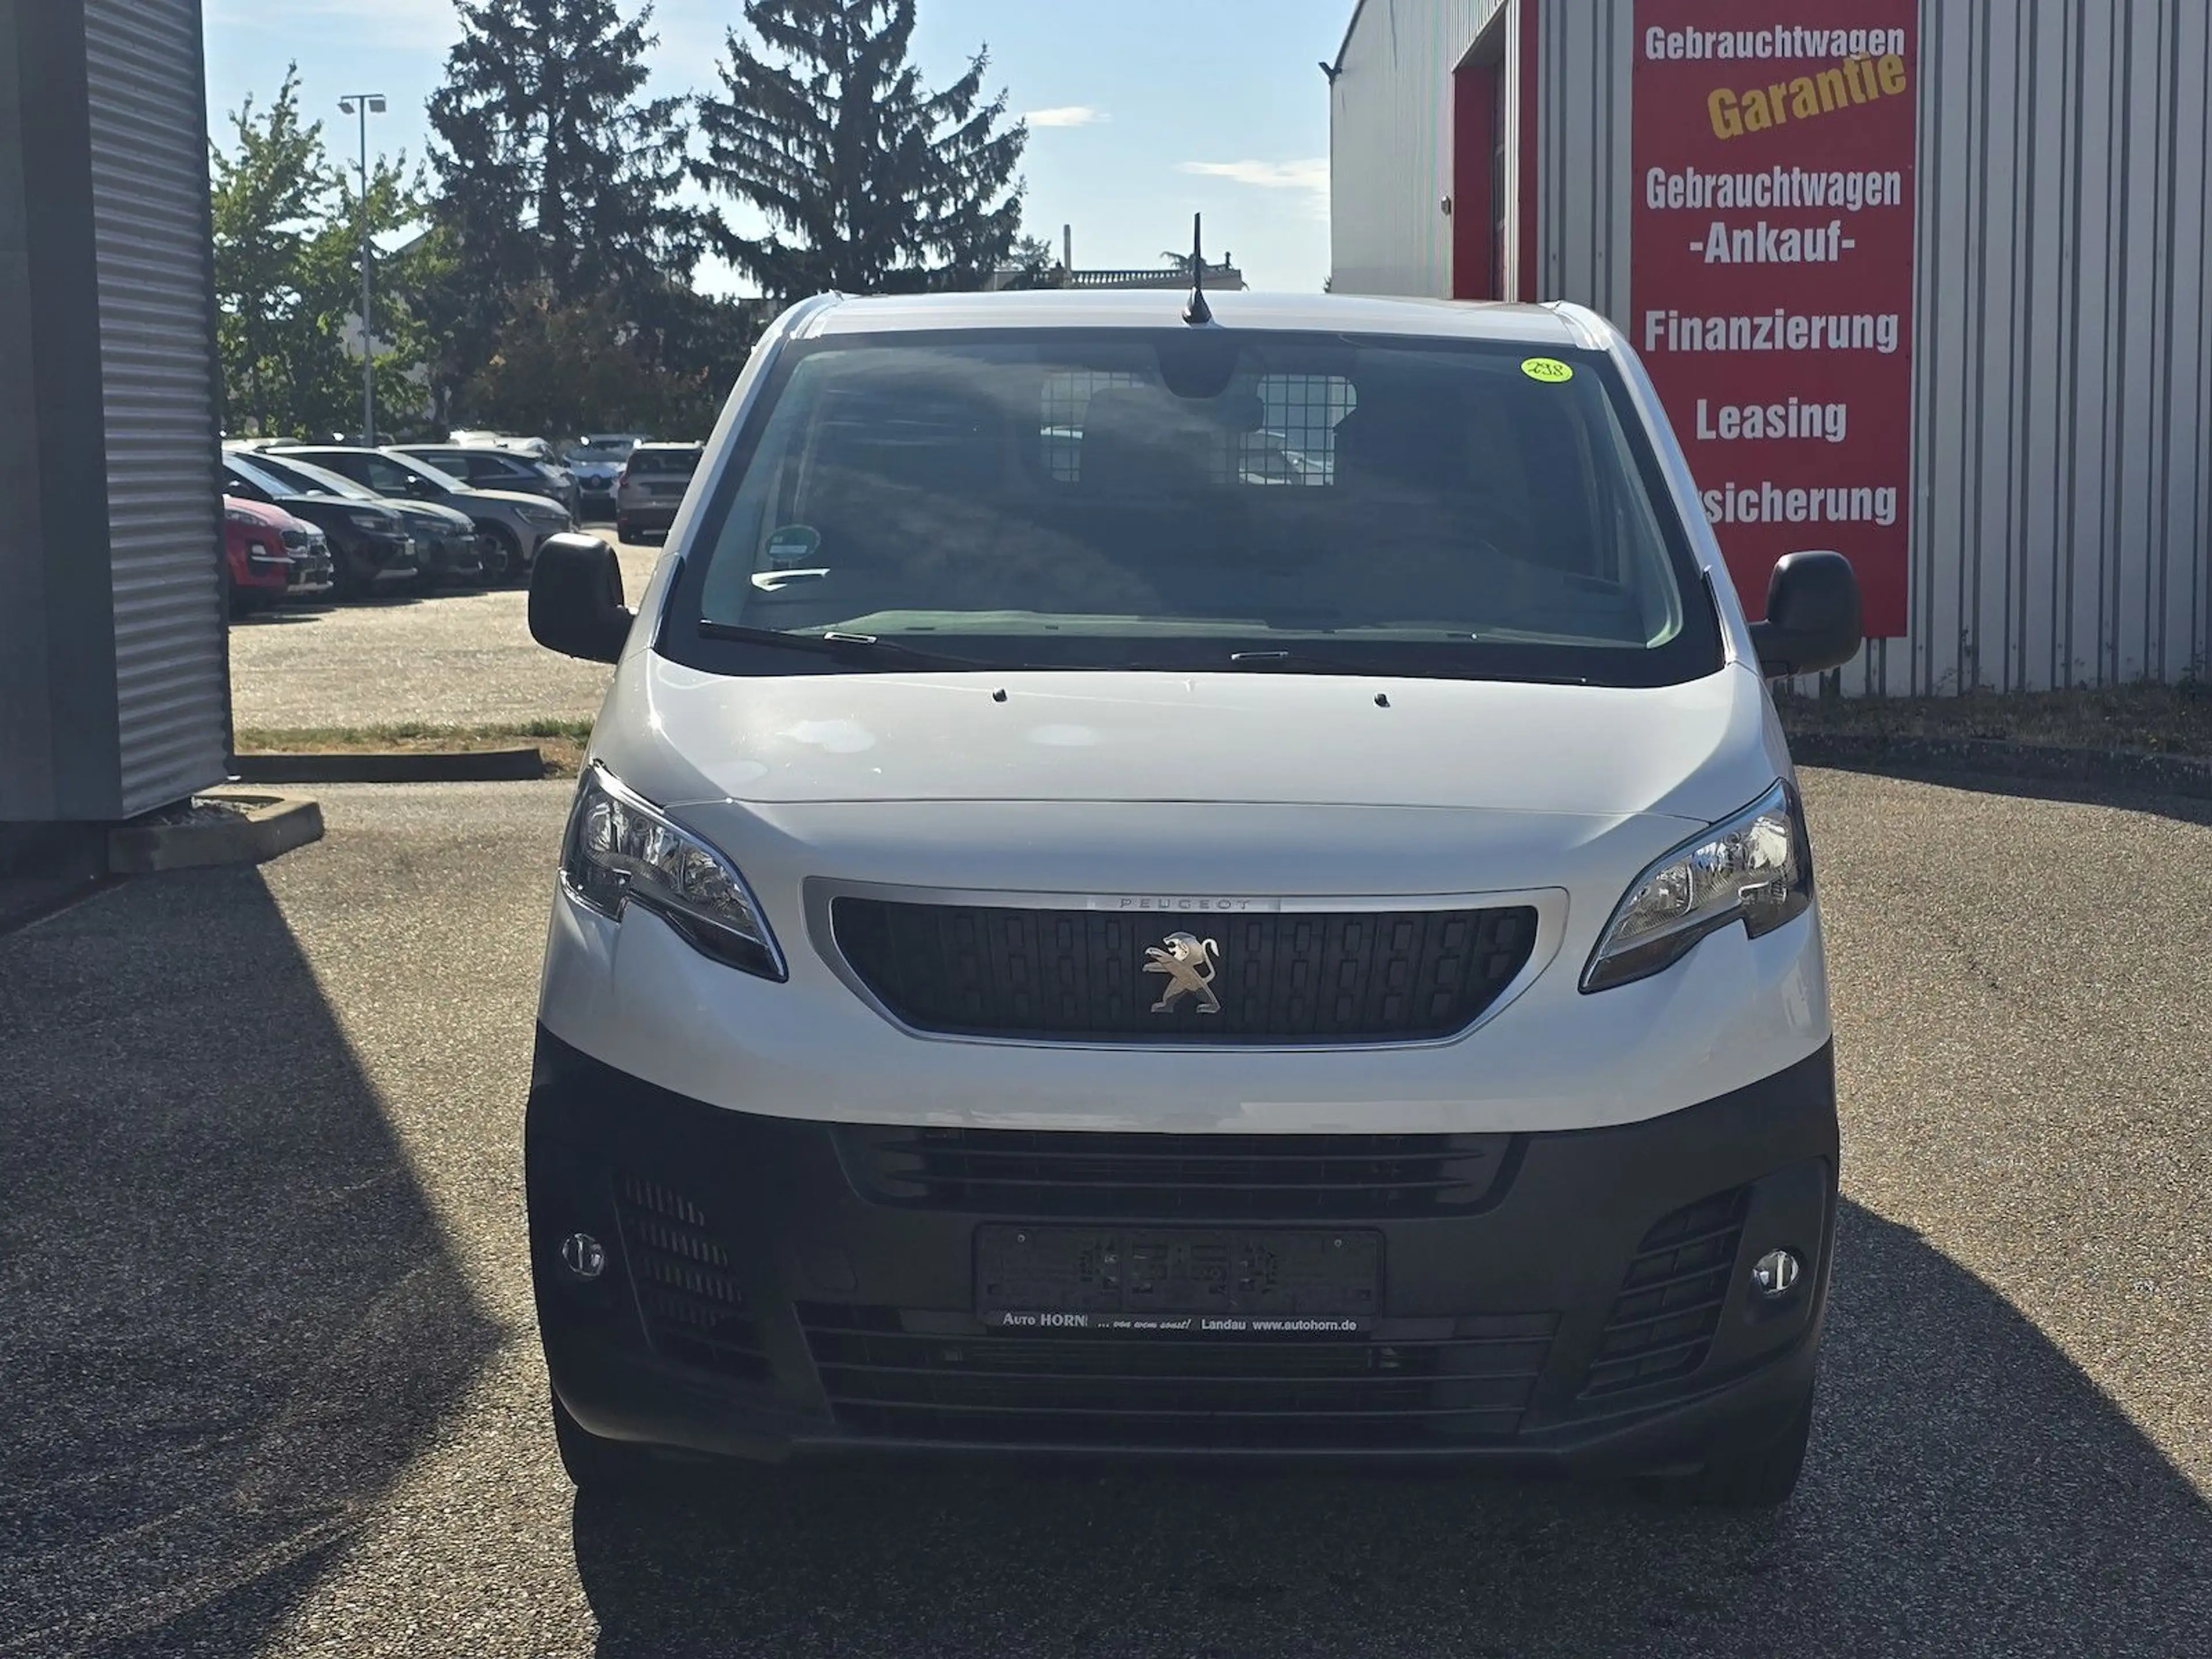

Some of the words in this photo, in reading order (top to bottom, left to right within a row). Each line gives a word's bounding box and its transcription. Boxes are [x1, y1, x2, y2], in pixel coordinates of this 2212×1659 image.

[1646, 25, 1904, 60] Gebrauchtwagen
[1707, 52, 1906, 139] Garantie
[1646, 166, 1901, 210] Gebrauchtwagen
[1690, 220, 1855, 263] -Ankauf-
[1646, 309, 1897, 353] Finanzierung
[1697, 397, 1846, 442] Leasing
[1699, 482, 1896, 525] sicherung
[1120, 898, 1249, 910] PEUGEOT
[1202, 1319, 1246, 1330] Landau
[1253, 1320, 1357, 1331] www.autohorn.de
